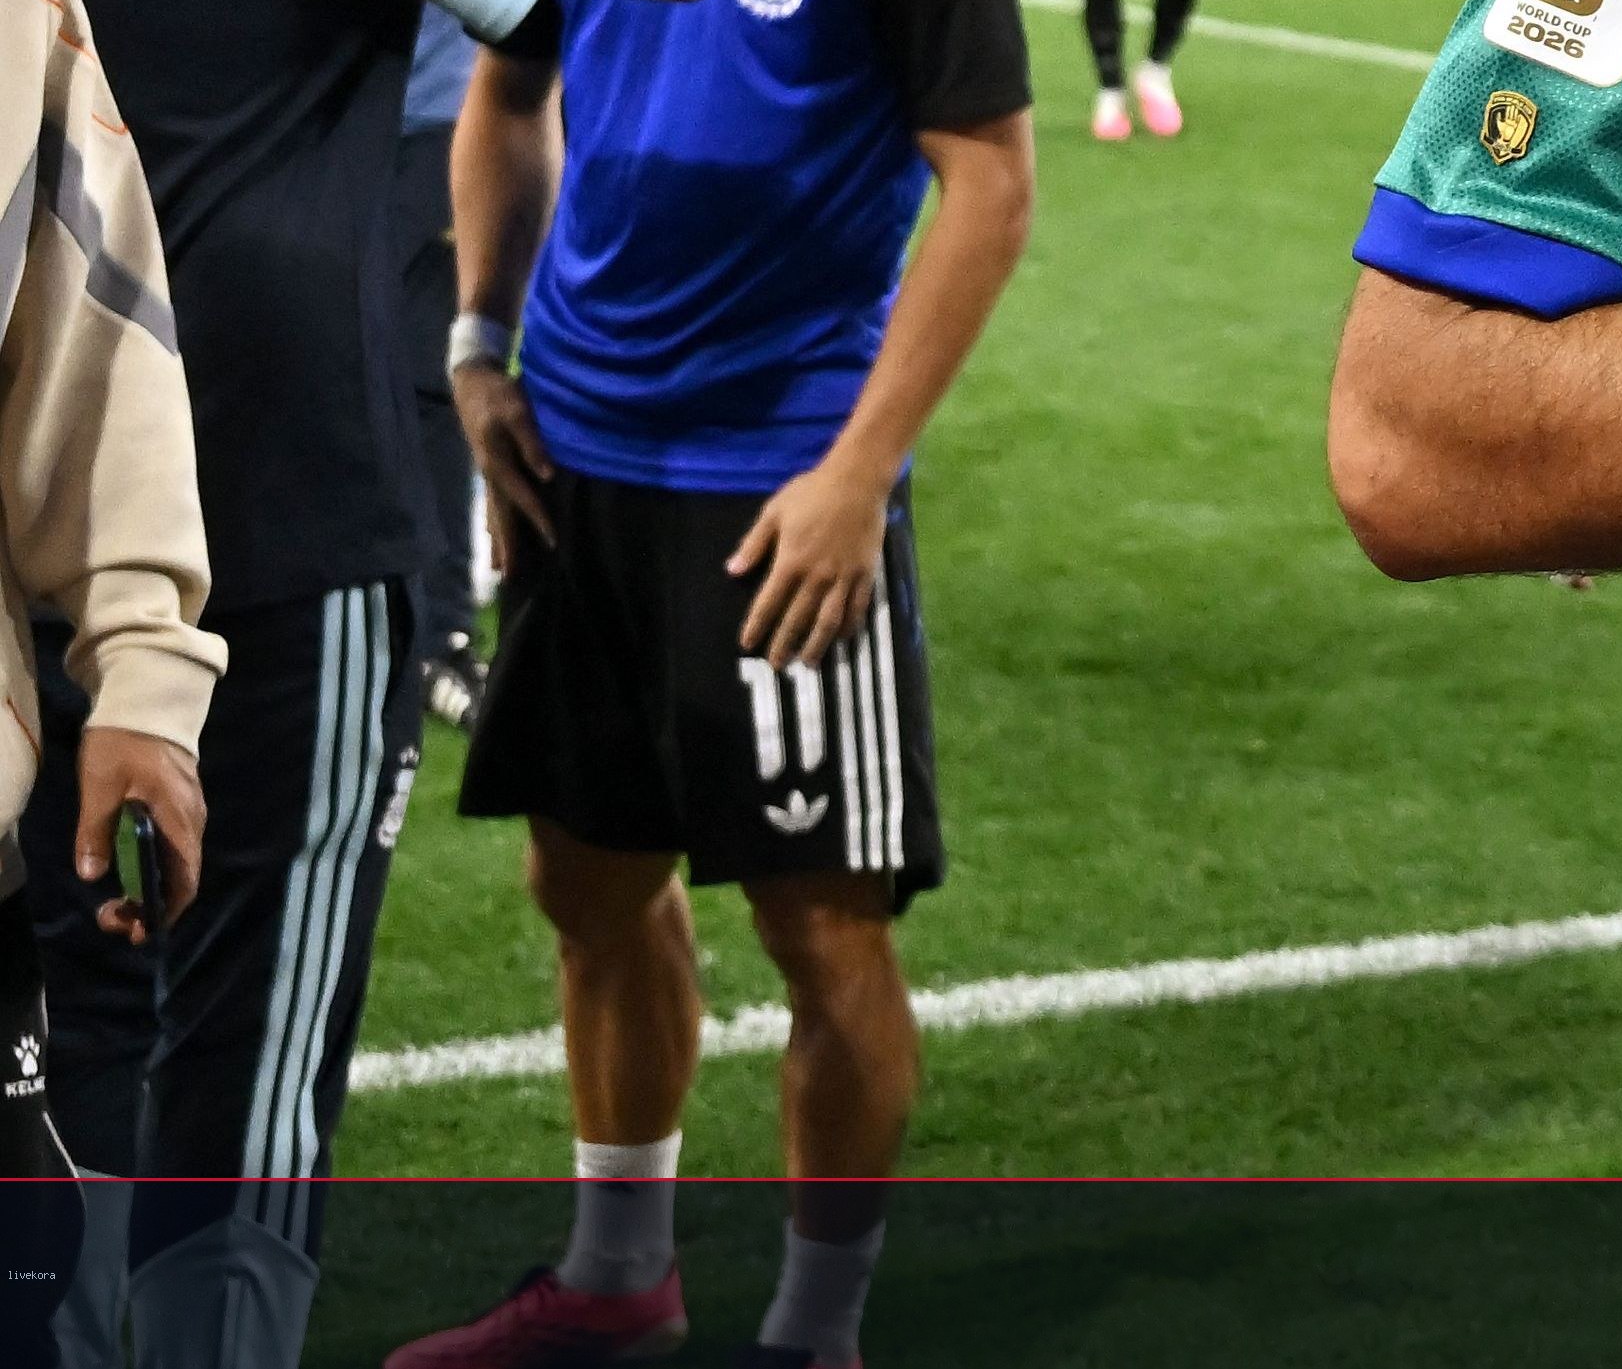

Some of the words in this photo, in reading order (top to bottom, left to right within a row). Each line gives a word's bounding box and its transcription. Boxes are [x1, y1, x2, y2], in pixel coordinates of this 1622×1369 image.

[1506, 14, 1586, 60] 2026
[1516, 0, 1563, 28] WORLD
[1562, 19, 1593, 38] CUP
[738, 657, 827, 782] 11
